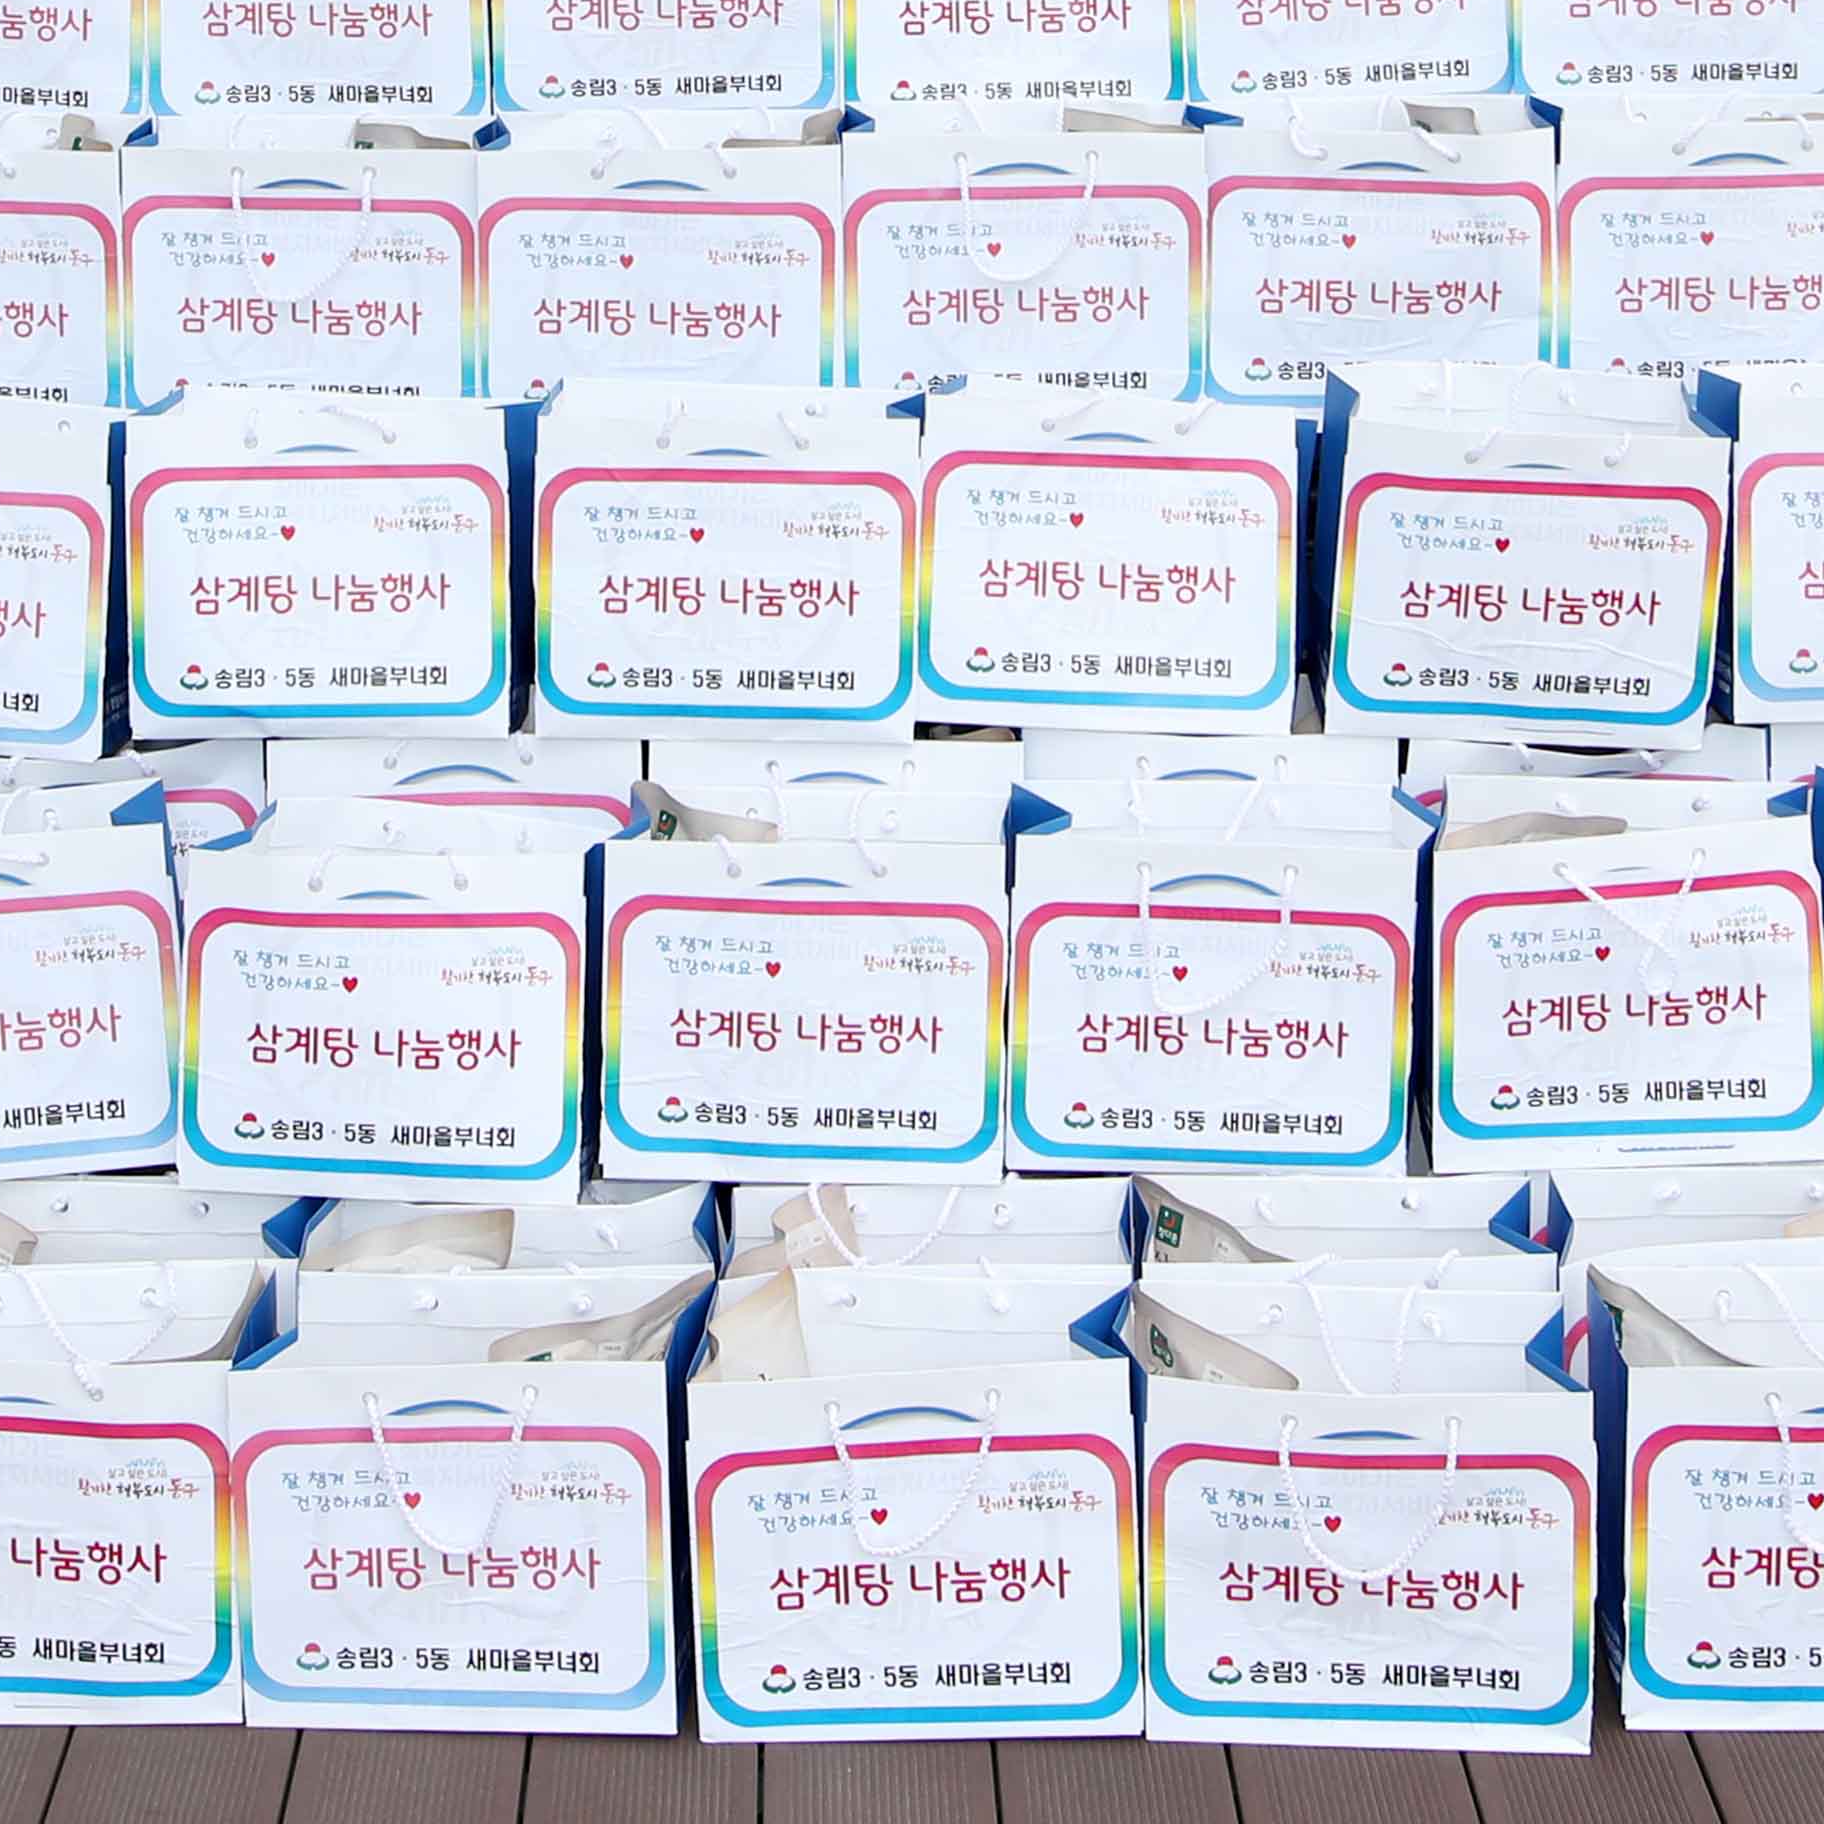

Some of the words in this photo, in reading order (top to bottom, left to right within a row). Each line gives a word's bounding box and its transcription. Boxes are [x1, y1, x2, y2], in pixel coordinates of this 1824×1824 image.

[205, 2, 295, 38] 삼계탕
[309, 3, 434, 39] 나눔행사
[898, 0, 994, 36] 삼계탕
[1007, 0, 1132, 33] 나눔행사
[905, 288, 1004, 326] 삼계탕
[1017, 287, 1150, 323] 나눔행사
[1256, 278, 1358, 316] 삼계탕
[1371, 281, 1502, 315] 나눔행사
[1617, 277, 1714, 313] 삼계탕
[178, 298, 277, 334] 삼계탕
[290, 299, 423, 337] 나눔행사
[535, 299, 636, 337] 삼계탕
[649, 303, 782, 339] 나눔행사
[190, 575, 299, 616] 삼계탕
[312, 574, 450, 613] 나눔행사
[600, 576, 706, 616] 삼계탕
[719, 577, 862, 619] 나눔행사
[978, 560, 1085, 601] 삼계탕
[1097, 565, 1237, 605] 나눔행사
[1399, 581, 1507, 623] 삼계탕
[1520, 587, 1663, 628] 나눔행사
[670, 1008, 783, 1053] 삼계탕
[797, 1014, 945, 1055] 나눔행사
[1502, 993, 1613, 1038] 삼계탕
[1624, 983, 1767, 1028] 나눔행사
[247, 1024, 361, 1069] 삼계탕
[373, 1028, 522, 1072] 나눔행사
[1076, 1013, 1187, 1056] 삼계탕
[1202, 1018, 1349, 1060] 나눔행사
[390, 1124, 516, 1149] 새마을부녀회
[9, 1536, 169, 1586] 나눔행사
[303, 1547, 428, 1591] 삼계탕
[441, 1545, 602, 1590] 나눔행사
[769, 1563, 896, 1611] 삼계탕
[909, 1557, 1073, 1604] 나눔행사
[1218, 1561, 1346, 1607] 삼계탕
[1360, 1568, 1527, 1611] 나눔행사
